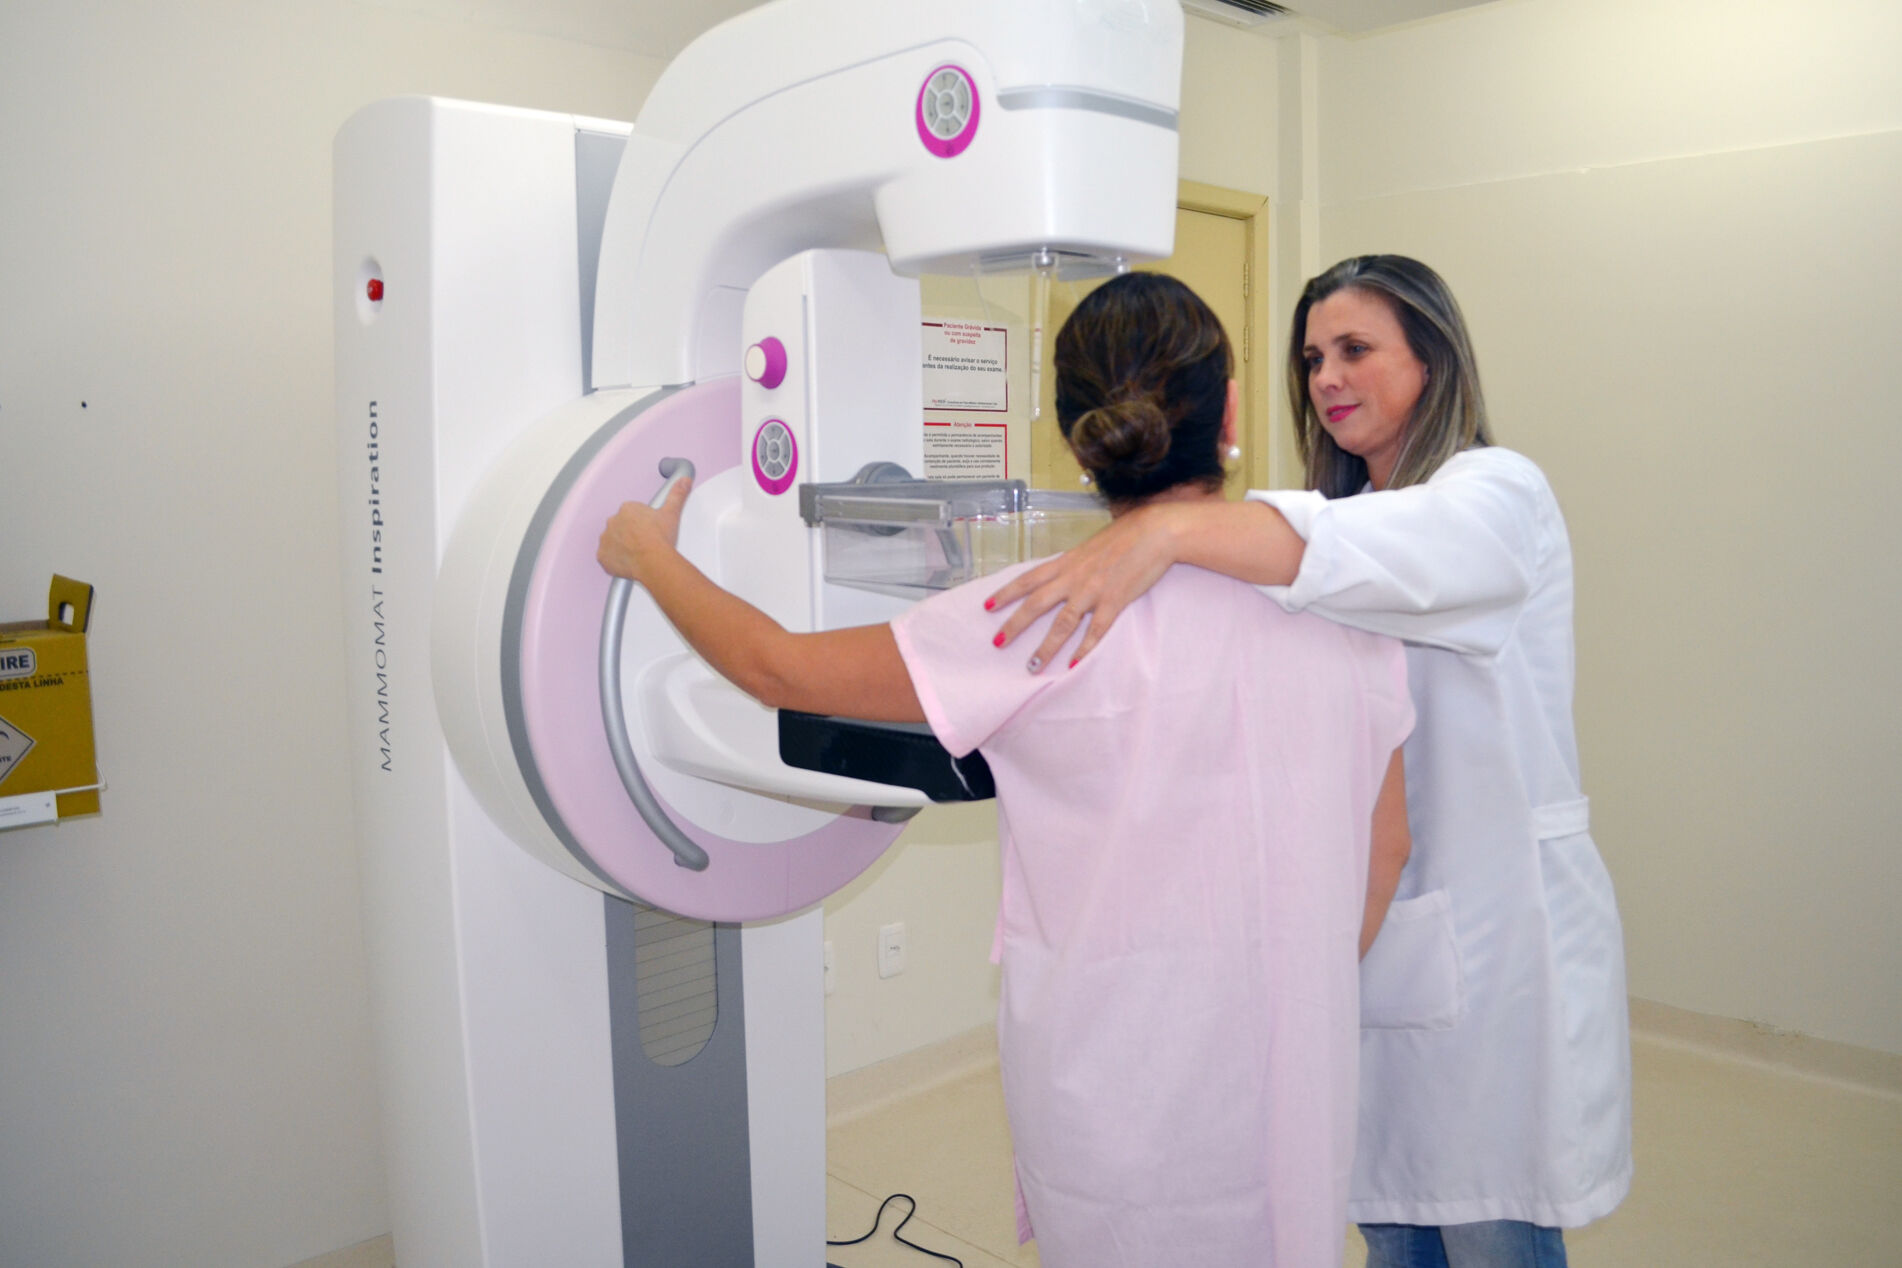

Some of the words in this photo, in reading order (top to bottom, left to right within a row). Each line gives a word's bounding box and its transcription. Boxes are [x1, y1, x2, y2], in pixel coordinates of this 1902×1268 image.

[933, 354, 960, 363] necessário
[944, 363, 969, 371] realização
[367, 400, 384, 574] Inspiration
[34, 677, 64, 688] LINHA
[372, 584, 392, 772] MAMMOMAT
